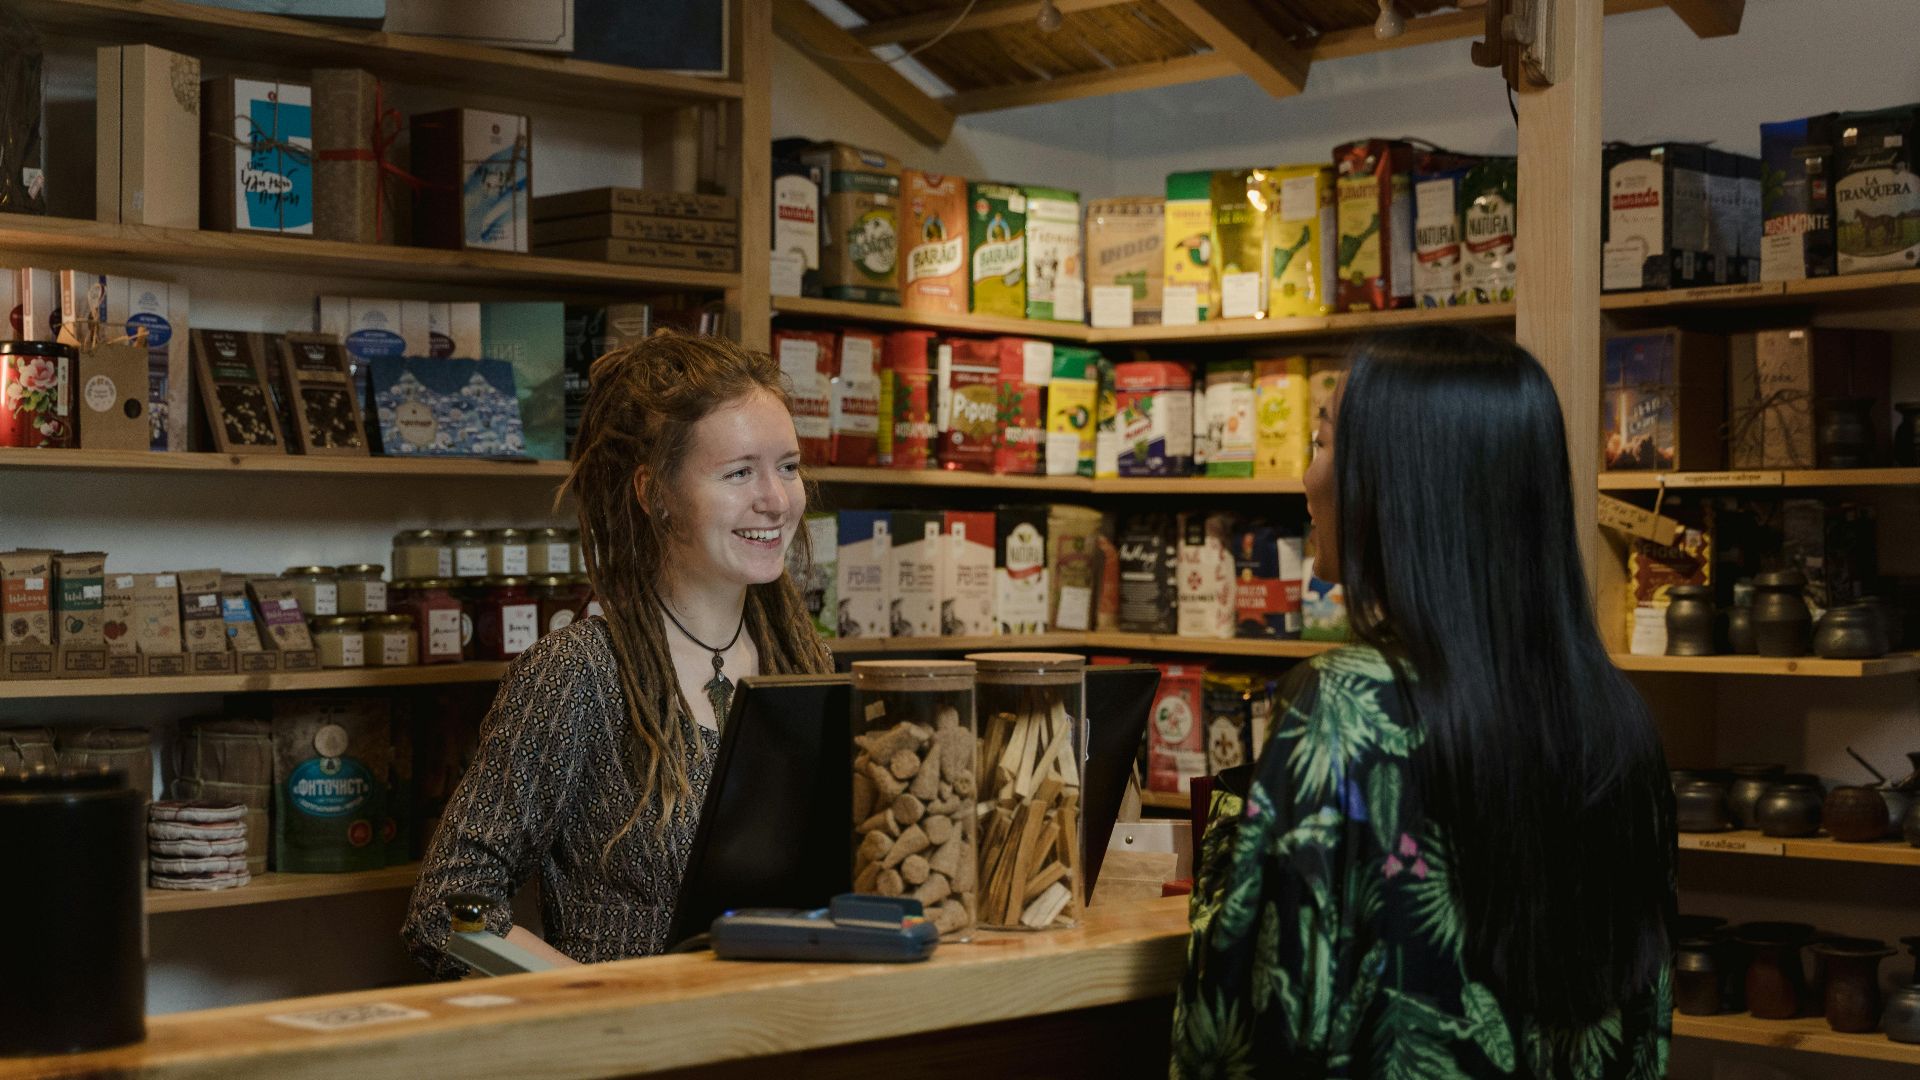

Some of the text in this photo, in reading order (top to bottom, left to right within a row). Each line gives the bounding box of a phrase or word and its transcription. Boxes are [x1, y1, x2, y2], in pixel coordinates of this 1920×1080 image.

[1839, 182, 1911, 203] TRANQUERA
[1865, 177, 1879, 187] LA
[1469, 213, 1509, 236] NATURA
[1765, 212, 1831, 236] ROSAMONTE
[1417, 225, 1456, 246] NATURA
